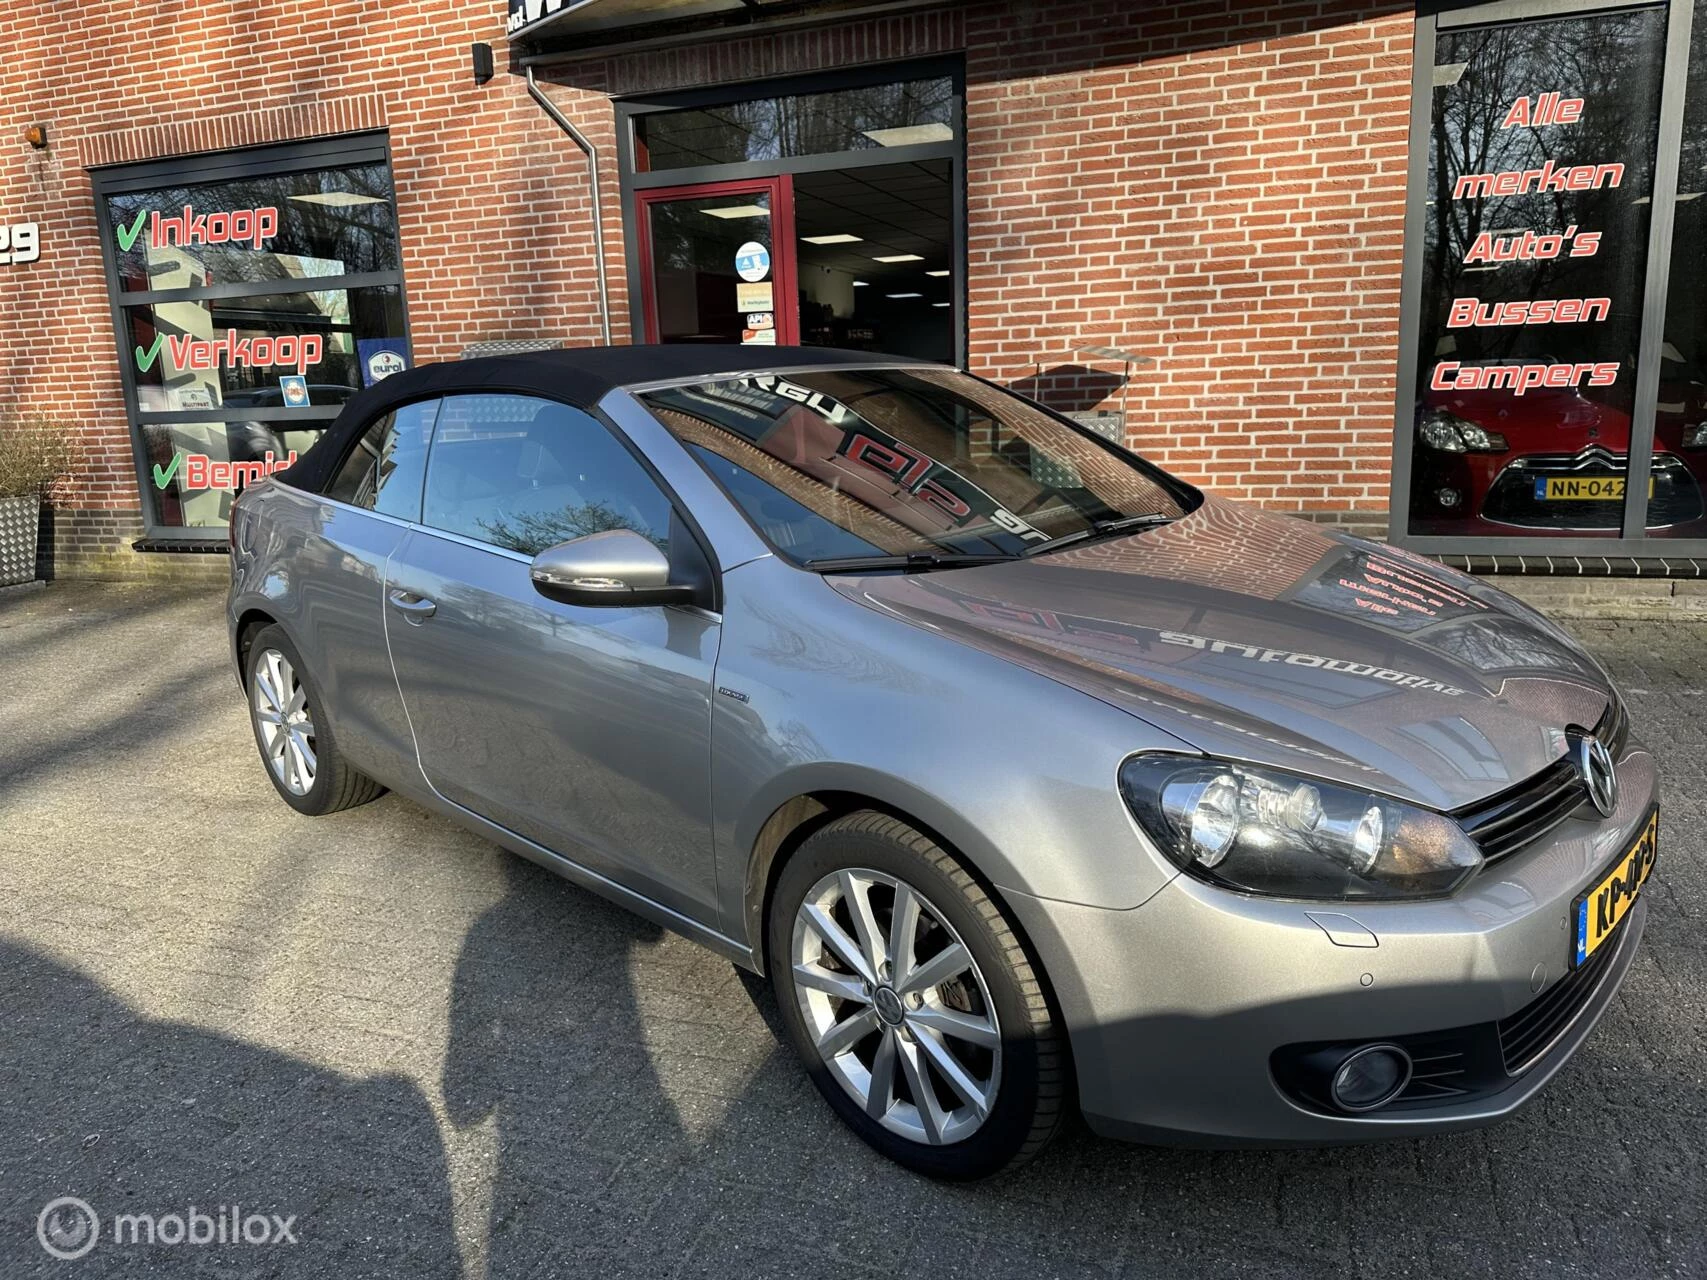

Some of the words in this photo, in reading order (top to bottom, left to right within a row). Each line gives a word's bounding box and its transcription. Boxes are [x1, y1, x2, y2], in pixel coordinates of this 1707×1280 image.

[1500, 91, 1585, 129] Alle
[1452, 160, 1625, 200] merken
[151, 205, 278, 250] Inkoop
[1462, 225, 1603, 264] Auto's
[1446, 297, 1612, 329] Bussen
[168, 328, 323, 375] Verkoop
[1430, 361, 1621, 396] Campers
